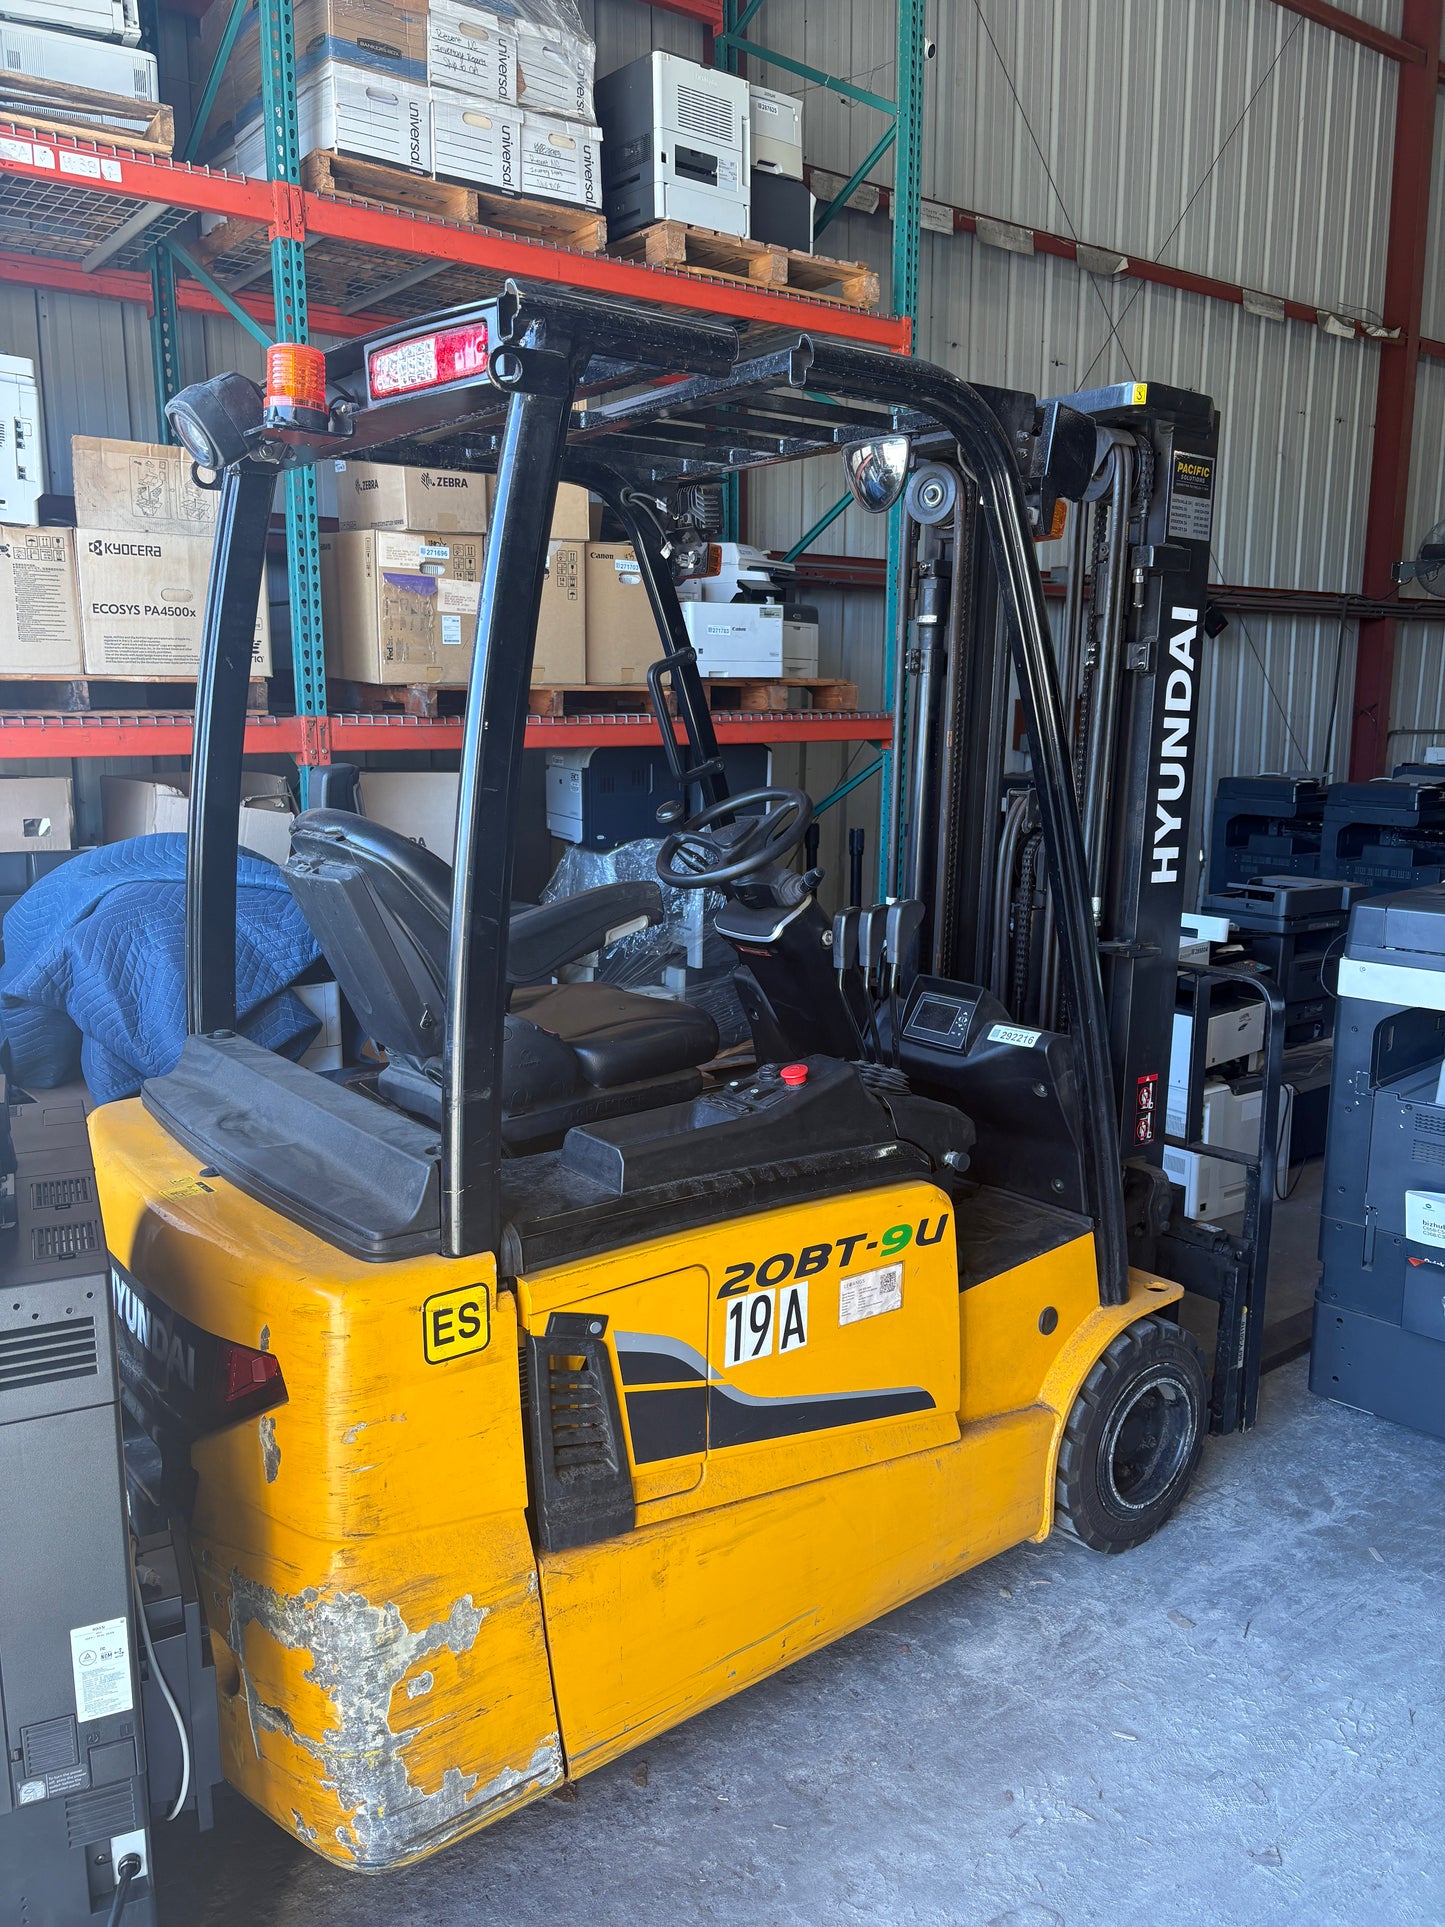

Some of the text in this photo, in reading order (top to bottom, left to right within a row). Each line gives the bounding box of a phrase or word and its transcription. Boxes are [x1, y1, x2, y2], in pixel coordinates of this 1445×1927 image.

[497, 38, 508, 101] universal
[409, 101, 423, 166] universal
[501, 125, 515, 188] universal
[583, 145, 597, 206] universal
[362, 479, 379, 490] ZEBRA
[437, 477, 468, 488] ZEBRA
[1177, 462, 1210, 478] PACIFIC
[105, 543, 161, 557] KYOCERA
[93, 603, 196, 617] ECOSYS PA4500x
[1151, 606, 1199, 884] HYUNDAI
[1000, 1031, 1035, 1046] 292216
[717, 1214, 949, 1299] 20BT-9U
[434, 1302, 481, 1347] ES
